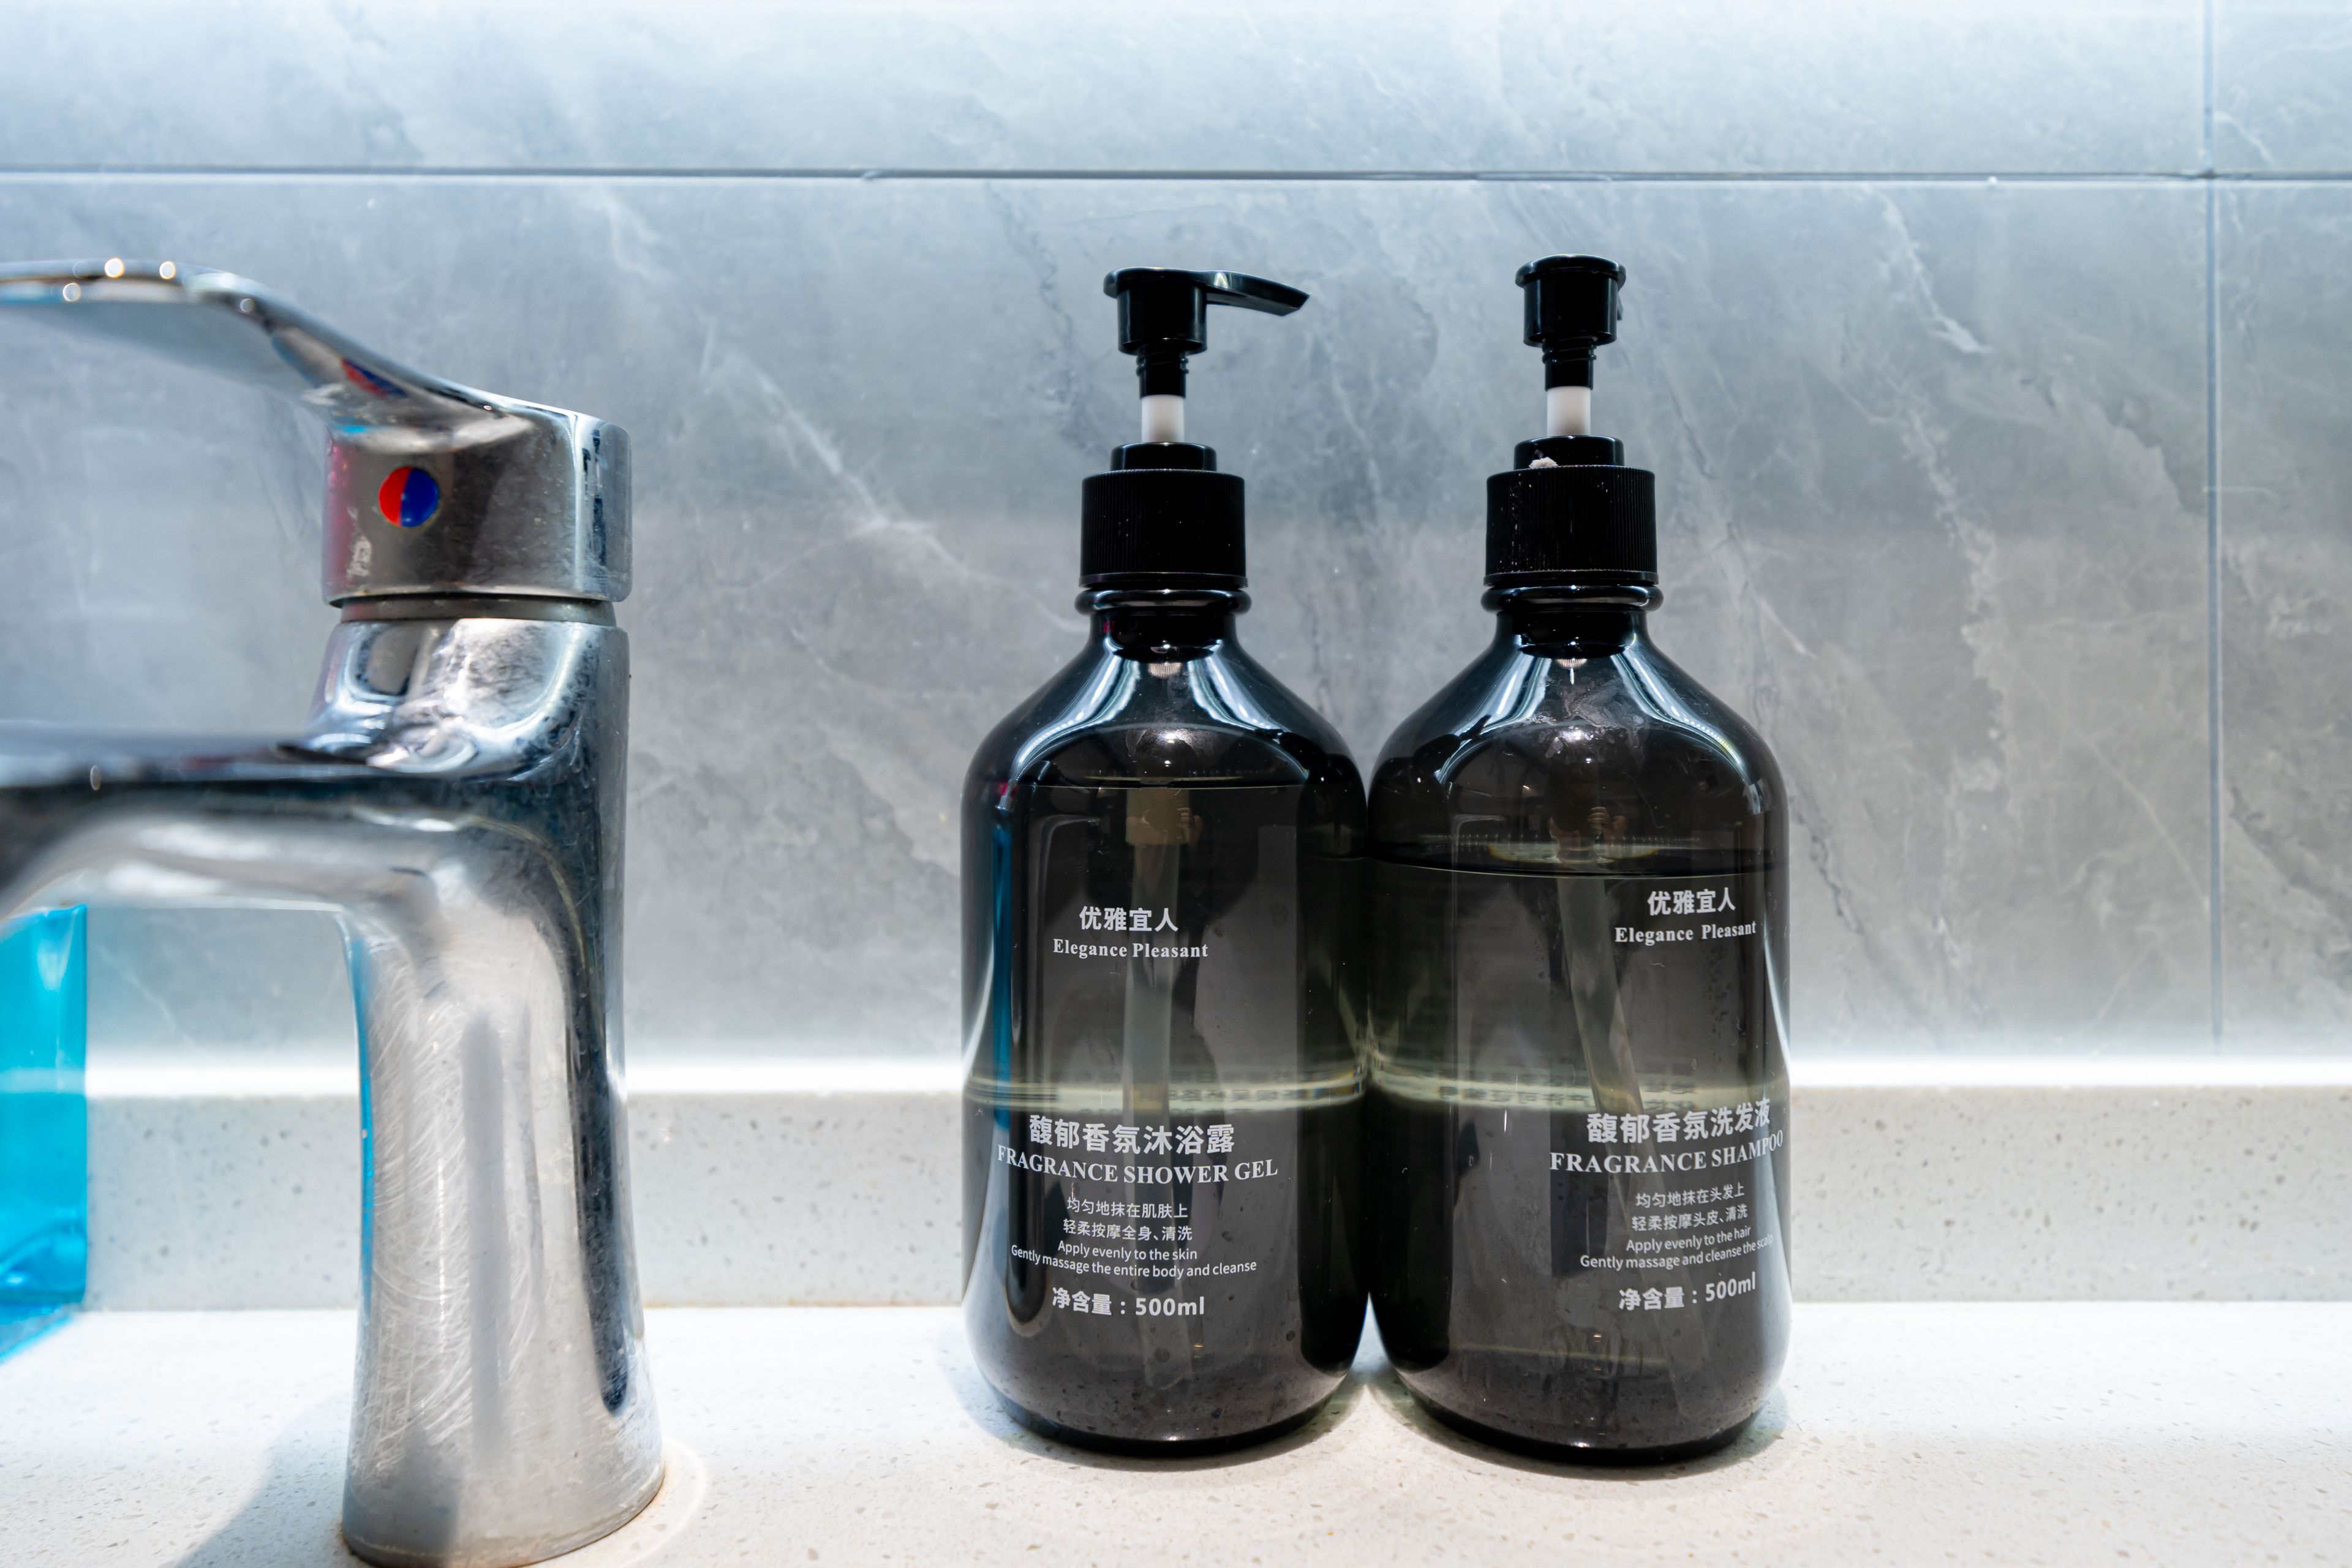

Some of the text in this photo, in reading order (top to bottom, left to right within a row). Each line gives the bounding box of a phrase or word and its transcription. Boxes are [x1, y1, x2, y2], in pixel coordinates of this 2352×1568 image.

[1647, 887, 1736, 916] 优雅宜人
[1079, 906, 1178, 932] 优雅宜人
[1615, 921, 1756, 946] Elegance Pleasant
[1053, 939, 1208, 959] Elegance Pleasant
[1030, 1115, 1234, 1155] 馥郁香氛沐浴露
[1586, 1098, 1771, 1144] 馥郁香氛洗发液
[998, 1144, 1278, 1184] FRAGRANCE SHOWER GEL
[1550, 1128, 1782, 1173] FRAGRANCE SHAMPOO
[1066, 1197, 1188, 1218] 均匀地抹在肌肤上
[1635, 1183, 1745, 1209] 均匀地抹在头发上
[1058, 1240, 1197, 1262] Apply evenly to the skin
[1626, 1227, 1751, 1254] Apply evenly to the hair
[1012, 1245, 1256, 1280] Gently massage the entire body and cleanse
[1580, 1255, 1623, 1271] Gently
[1626, 1257, 1679, 1270] massage
[1682, 1251, 1703, 1265] and
[1705, 1247, 1741, 1262] cleanse
[1743, 1242, 1756, 1254] the
